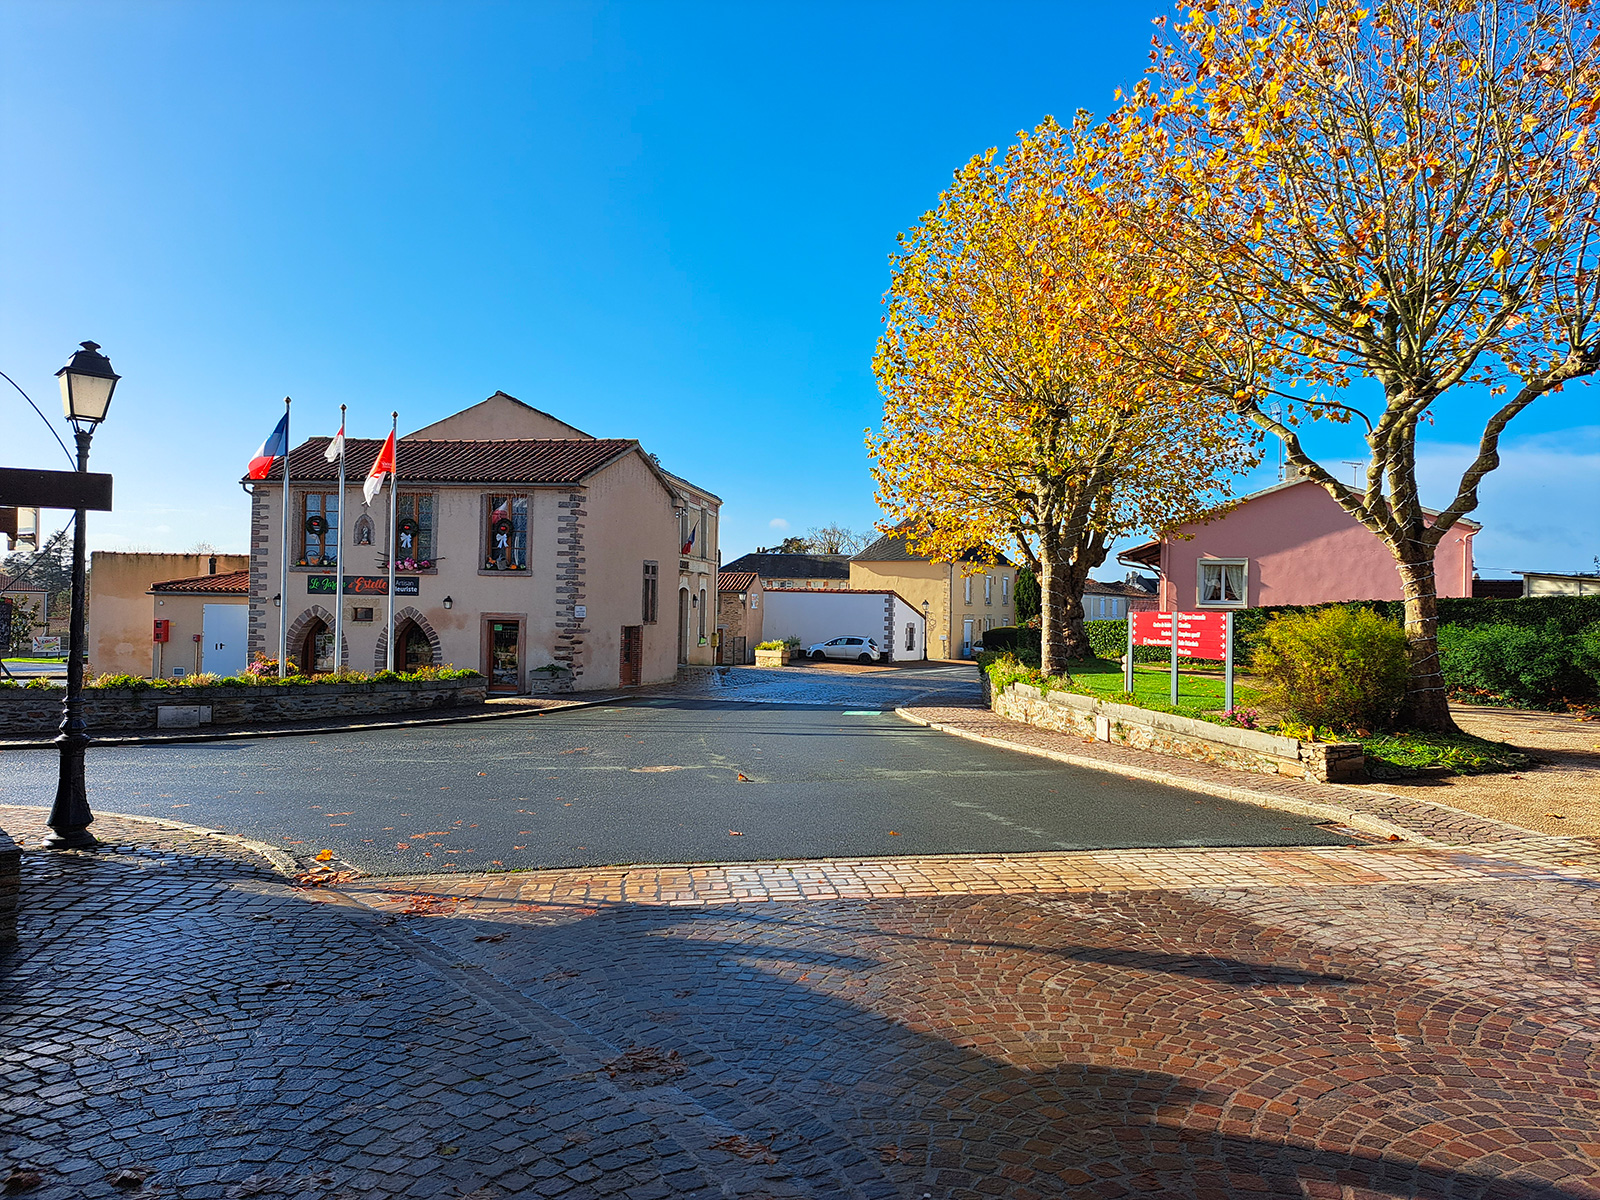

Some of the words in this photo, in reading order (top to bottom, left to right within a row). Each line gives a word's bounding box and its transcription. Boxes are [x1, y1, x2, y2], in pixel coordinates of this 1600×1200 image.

[309, 577, 320, 590] Le
[321, 577, 346, 590] Jarn
[354, 576, 388, 594] Estelle
